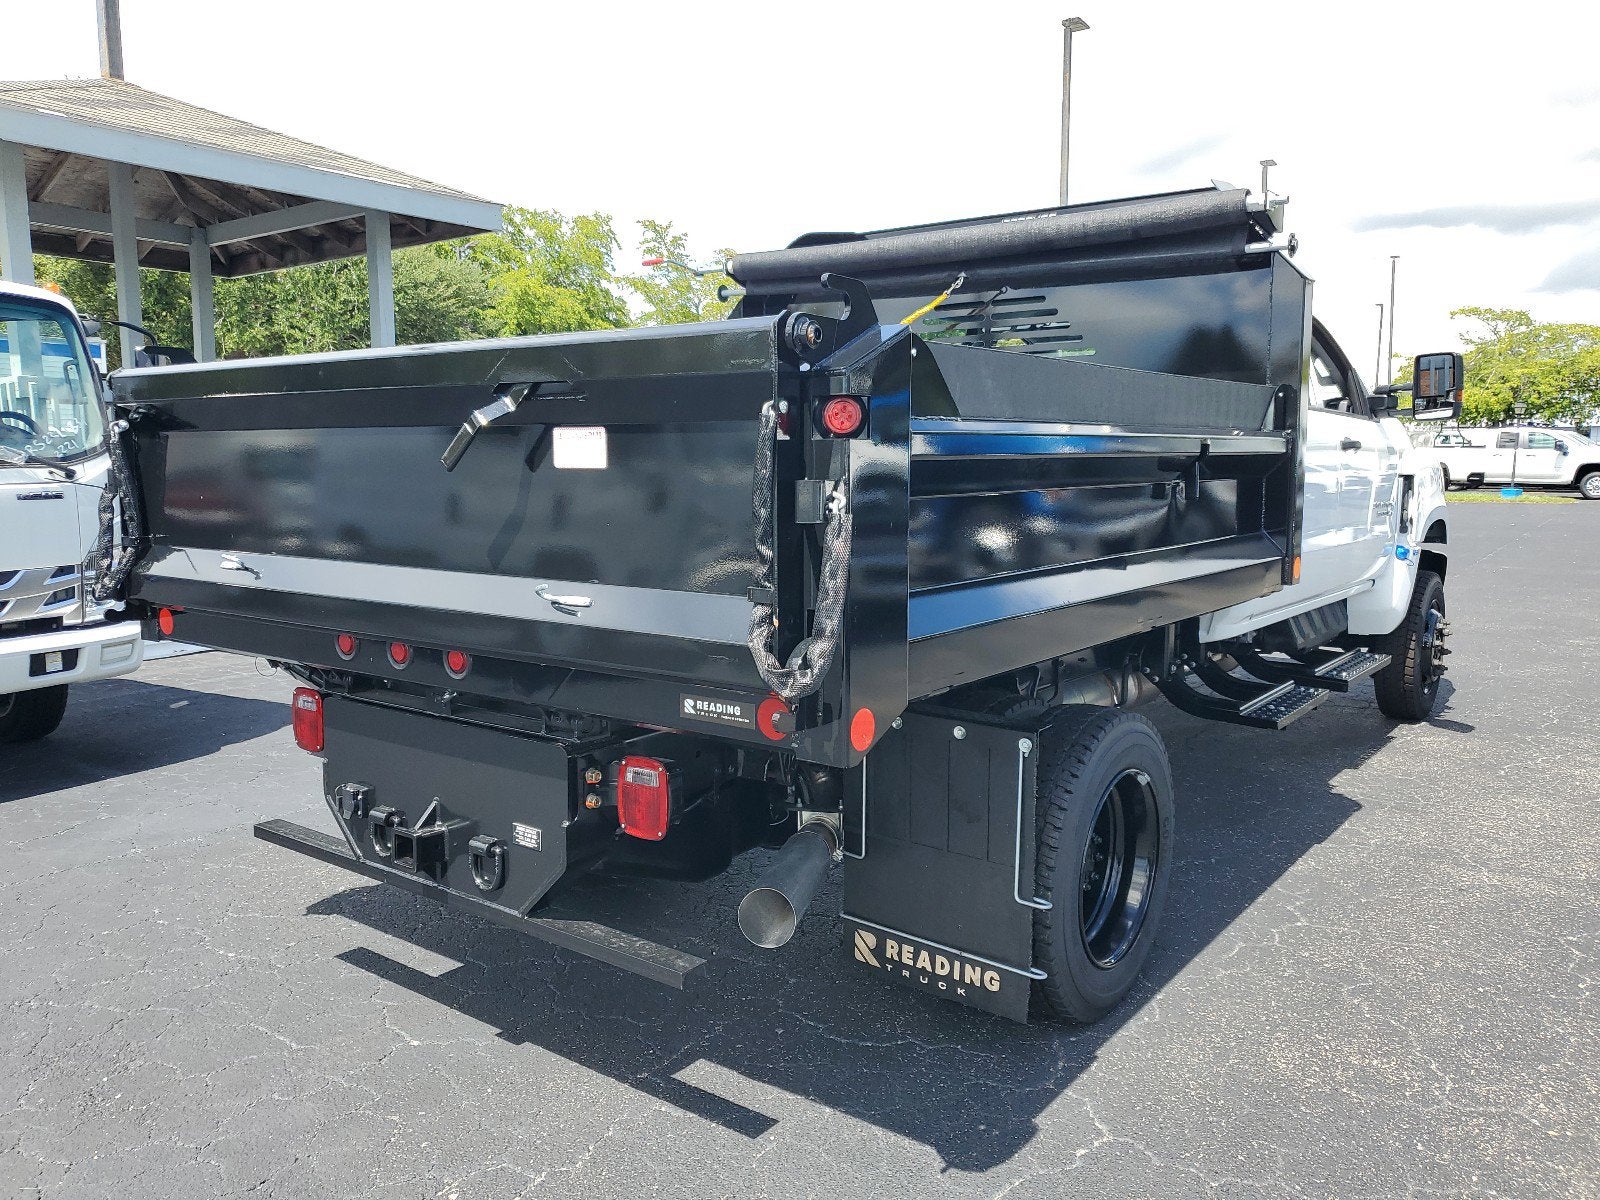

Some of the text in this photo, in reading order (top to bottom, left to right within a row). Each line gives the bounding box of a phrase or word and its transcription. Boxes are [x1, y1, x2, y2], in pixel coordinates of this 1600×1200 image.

[696, 700, 741, 715] READING
[885, 938, 1001, 992] READING
[885, 963, 966, 997] TRUCK
